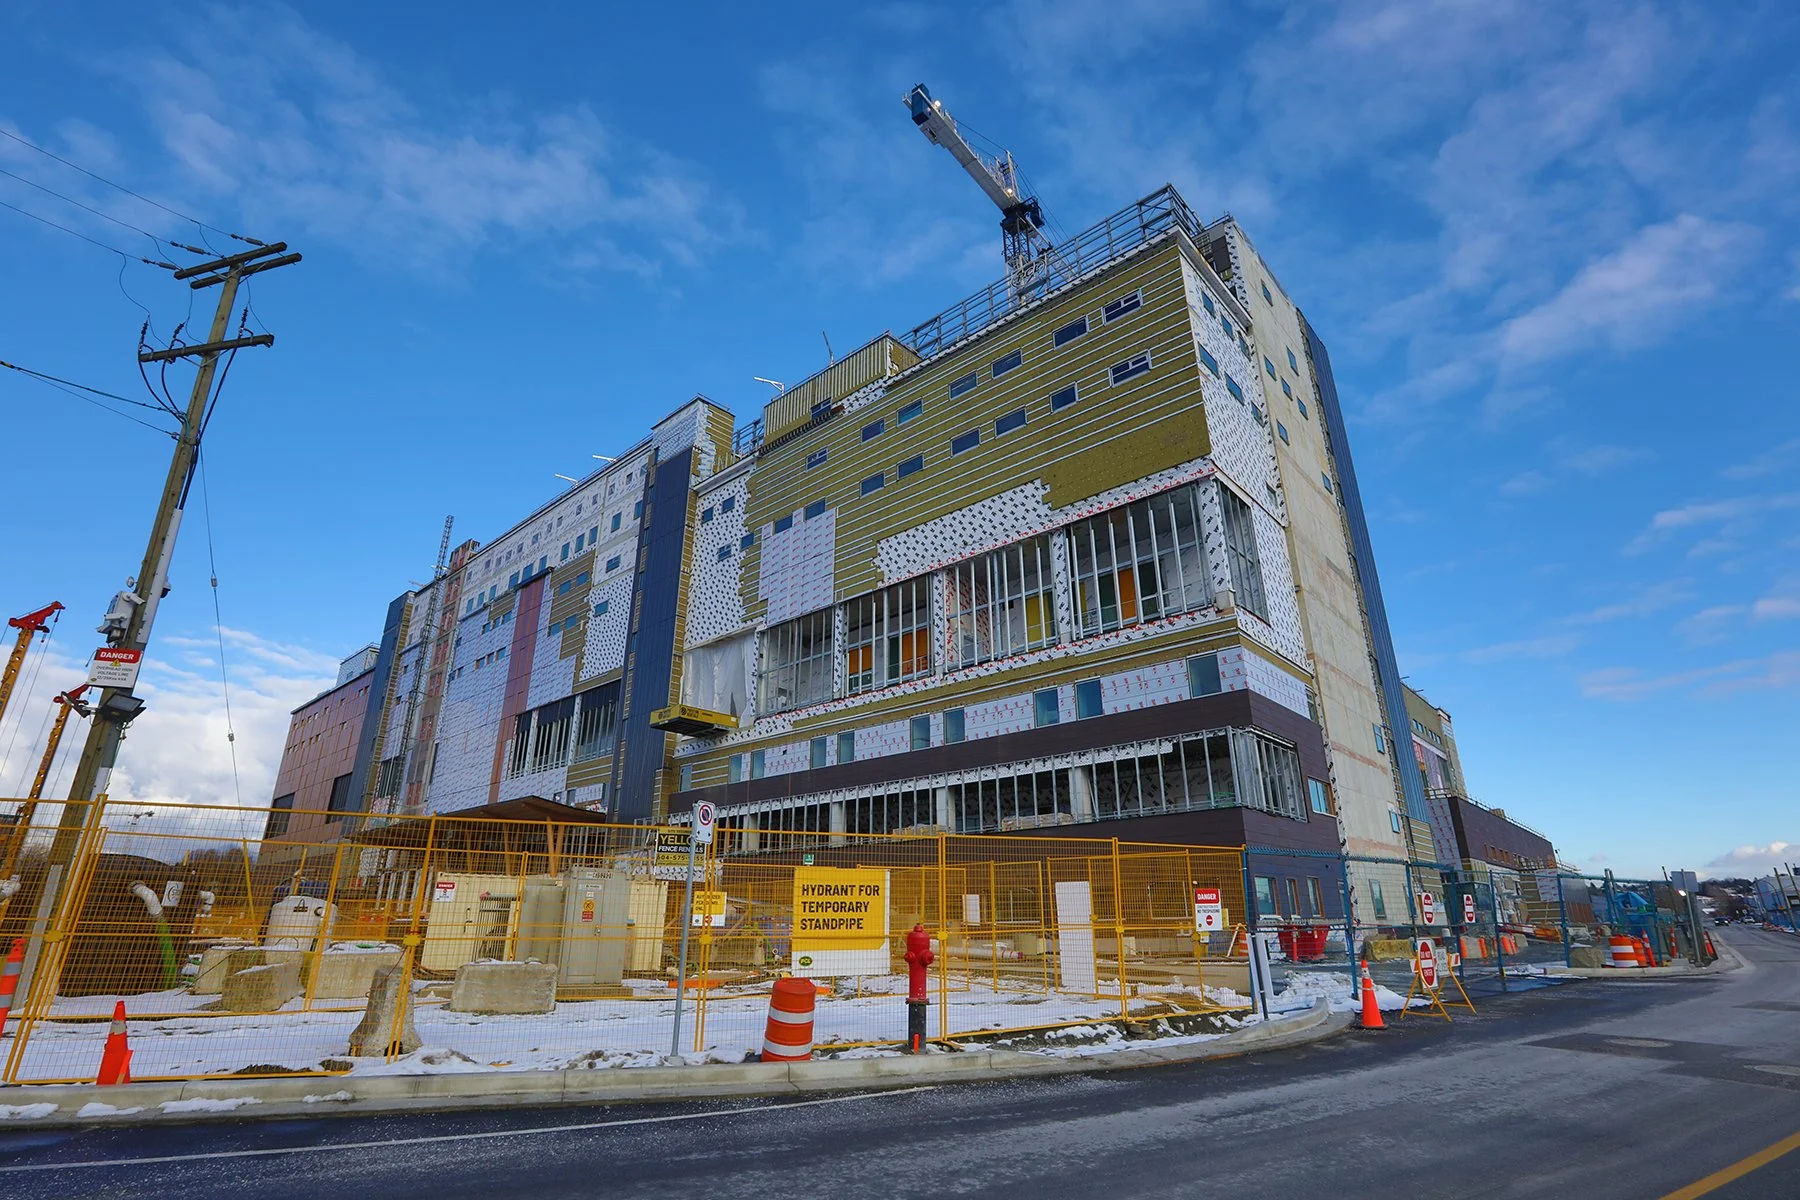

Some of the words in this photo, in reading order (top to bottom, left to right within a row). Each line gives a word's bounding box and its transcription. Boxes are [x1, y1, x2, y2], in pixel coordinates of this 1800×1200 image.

[100, 651, 134, 660] DANGER
[801, 884, 856, 896] HYDRANT
[858, 885, 880, 896] FOR
[801, 901, 870, 913] TEMPORARY
[800, 917, 864, 930] STANDPIPE
